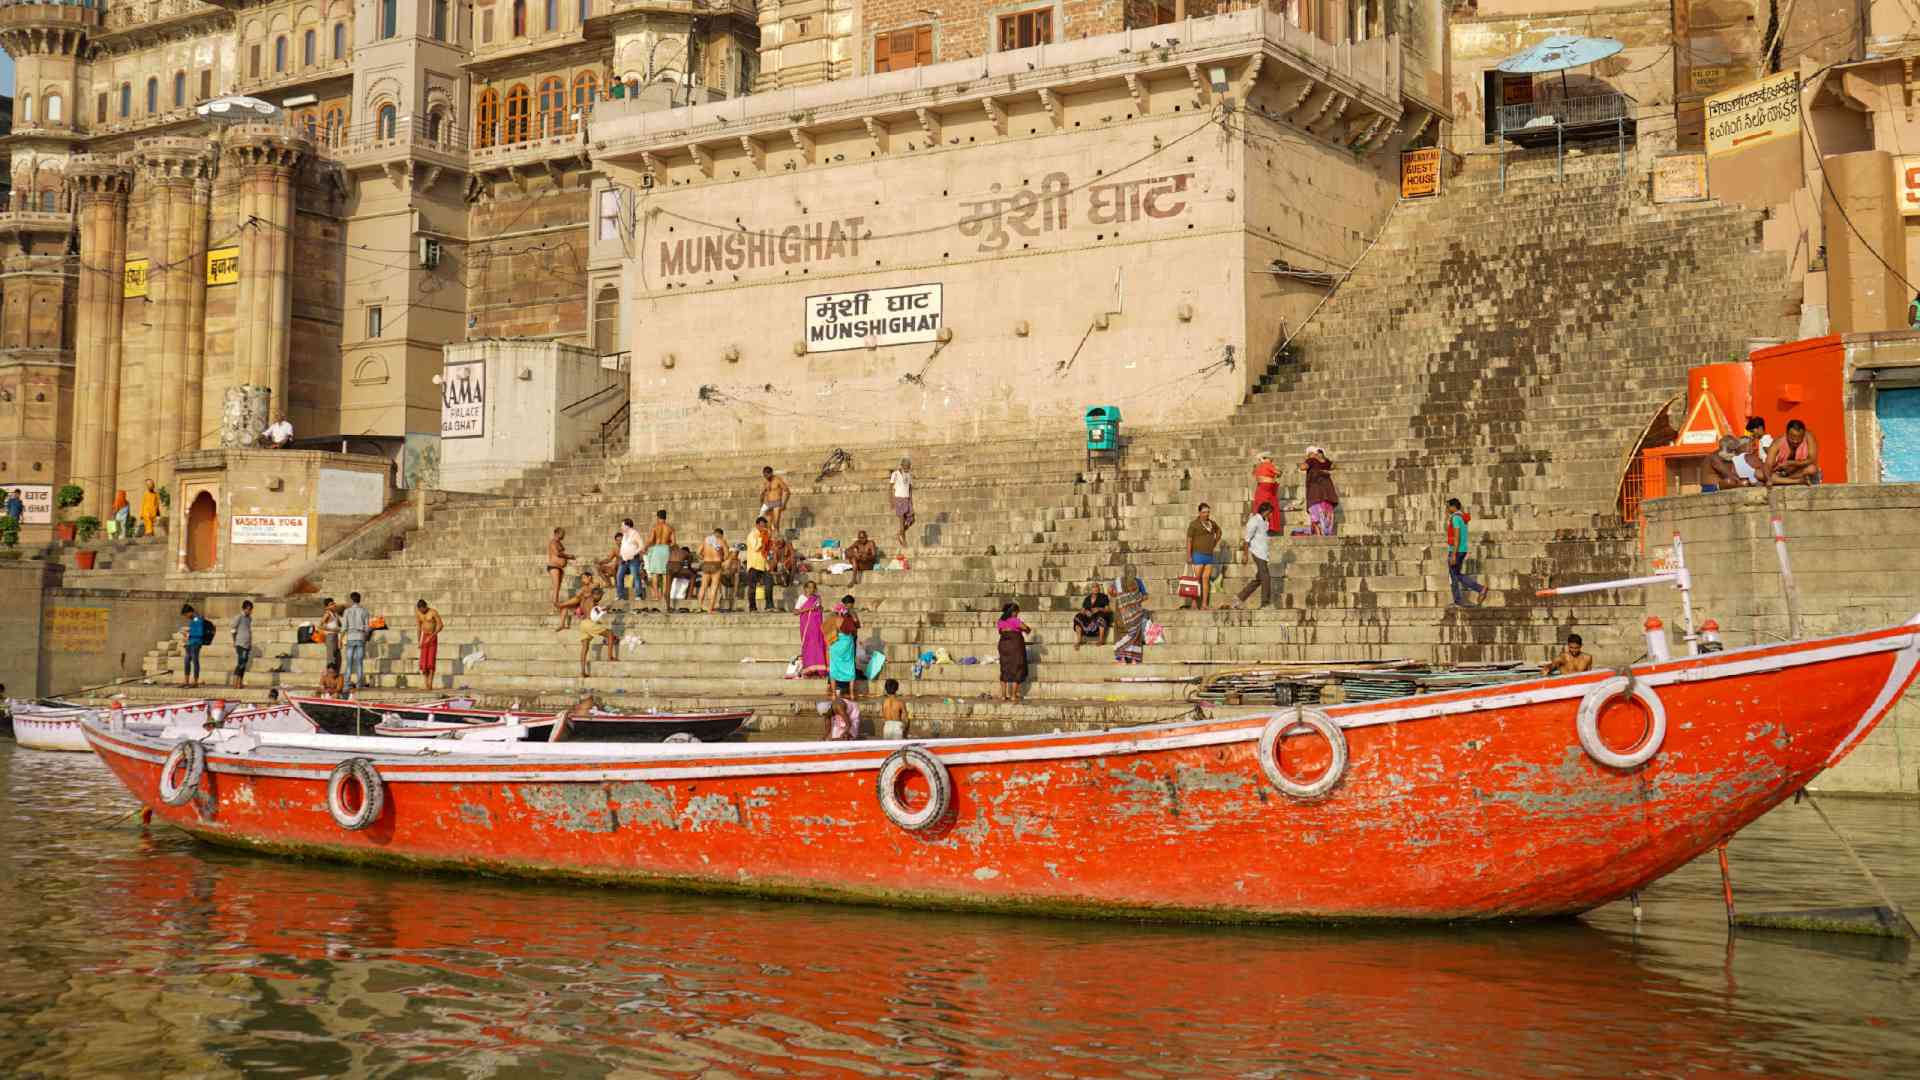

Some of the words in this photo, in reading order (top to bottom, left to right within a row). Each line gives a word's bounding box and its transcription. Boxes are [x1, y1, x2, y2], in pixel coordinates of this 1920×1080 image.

[1407, 163, 1434, 173] GUEST
[1407, 174, 1436, 184] HOUSE
[958, 171, 1073, 252] मुंशी
[1088, 173, 1195, 225] घाट
[816, 293, 872, 323] मुंशी
[885, 292, 932, 312] घाट
[811, 313, 939, 342] MUNSHIGHAT
[450, 407, 480, 418] PALACE
[455, 420, 477, 432] GHAT
[25, 491, 48, 500] घाट
